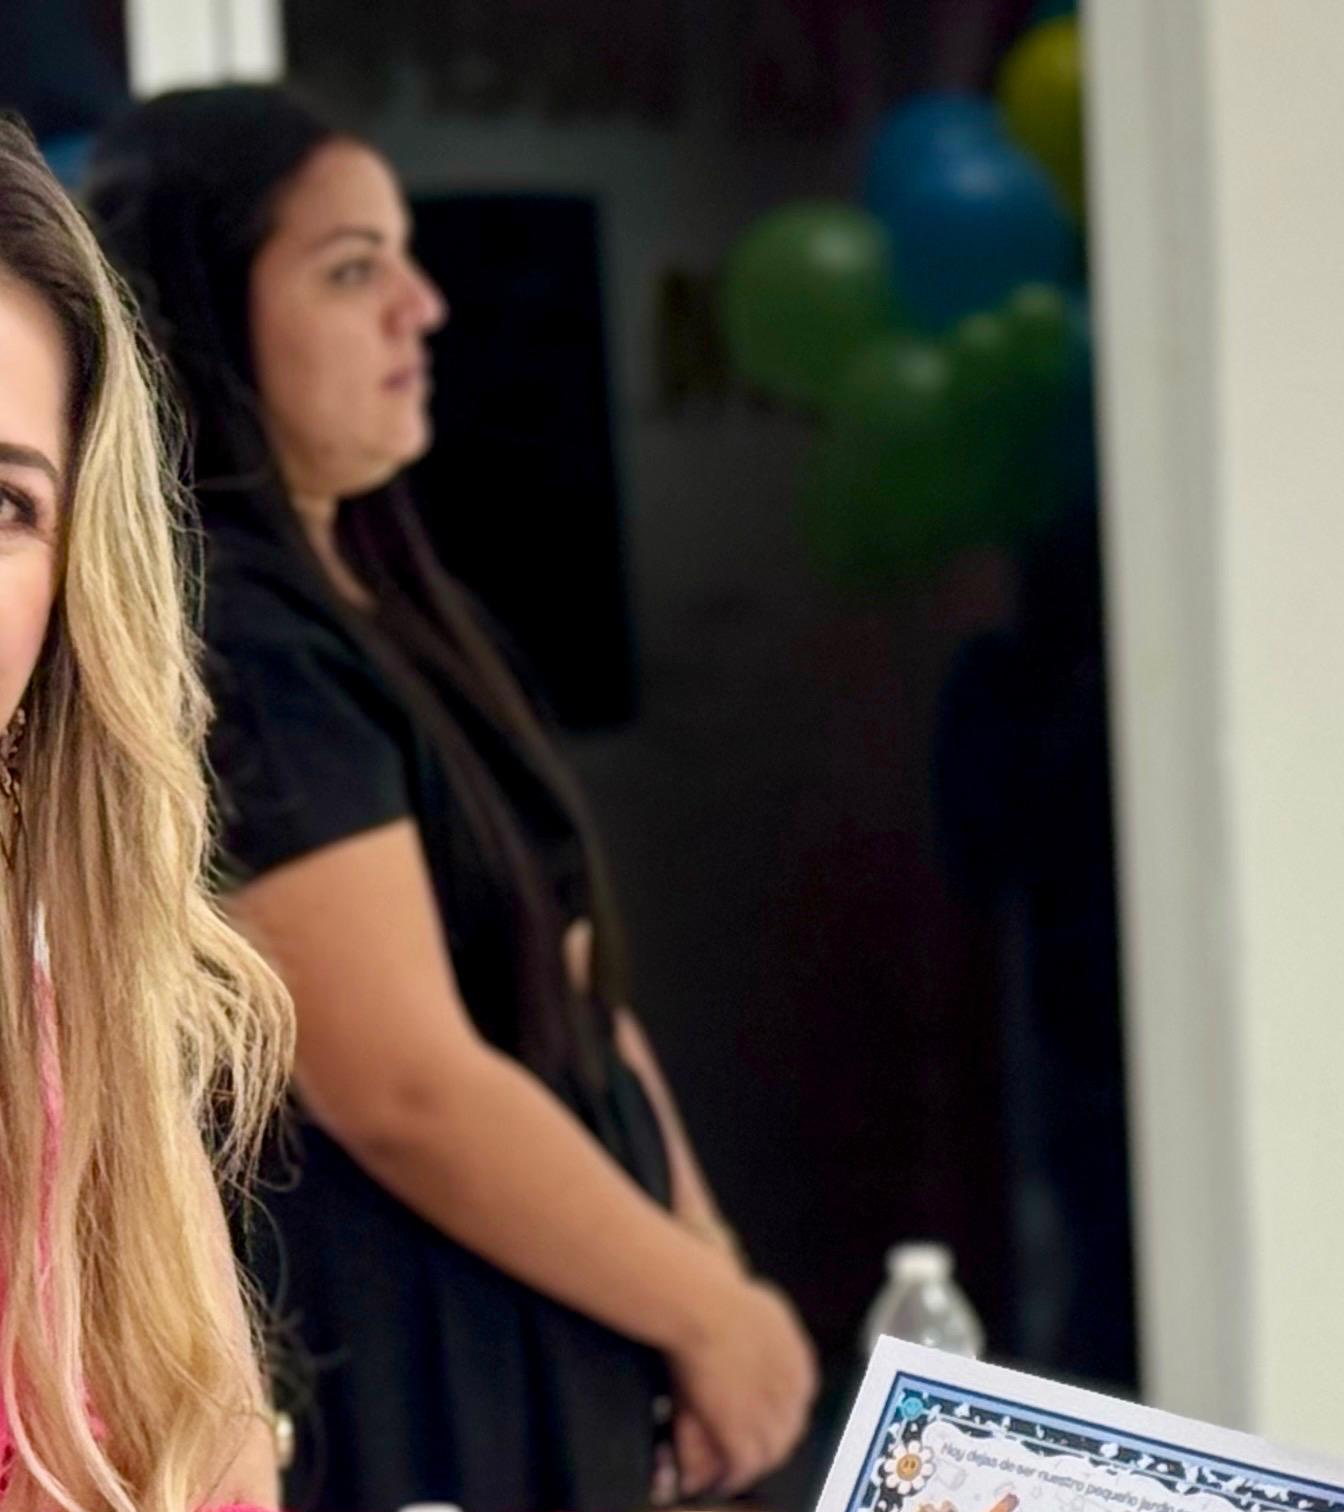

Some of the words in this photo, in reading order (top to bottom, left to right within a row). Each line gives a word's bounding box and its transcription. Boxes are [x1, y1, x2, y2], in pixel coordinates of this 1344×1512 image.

[941, 1443, 965, 1463] Hoy
[966, 1449, 997, 1470] dejas
[999, 1459, 1016, 1471] de
[1016, 1464, 1037, 1477] ser
[1038, 1470, 1085, 1491] nuestro
[1084, 1482, 1138, 1506] pequeño
